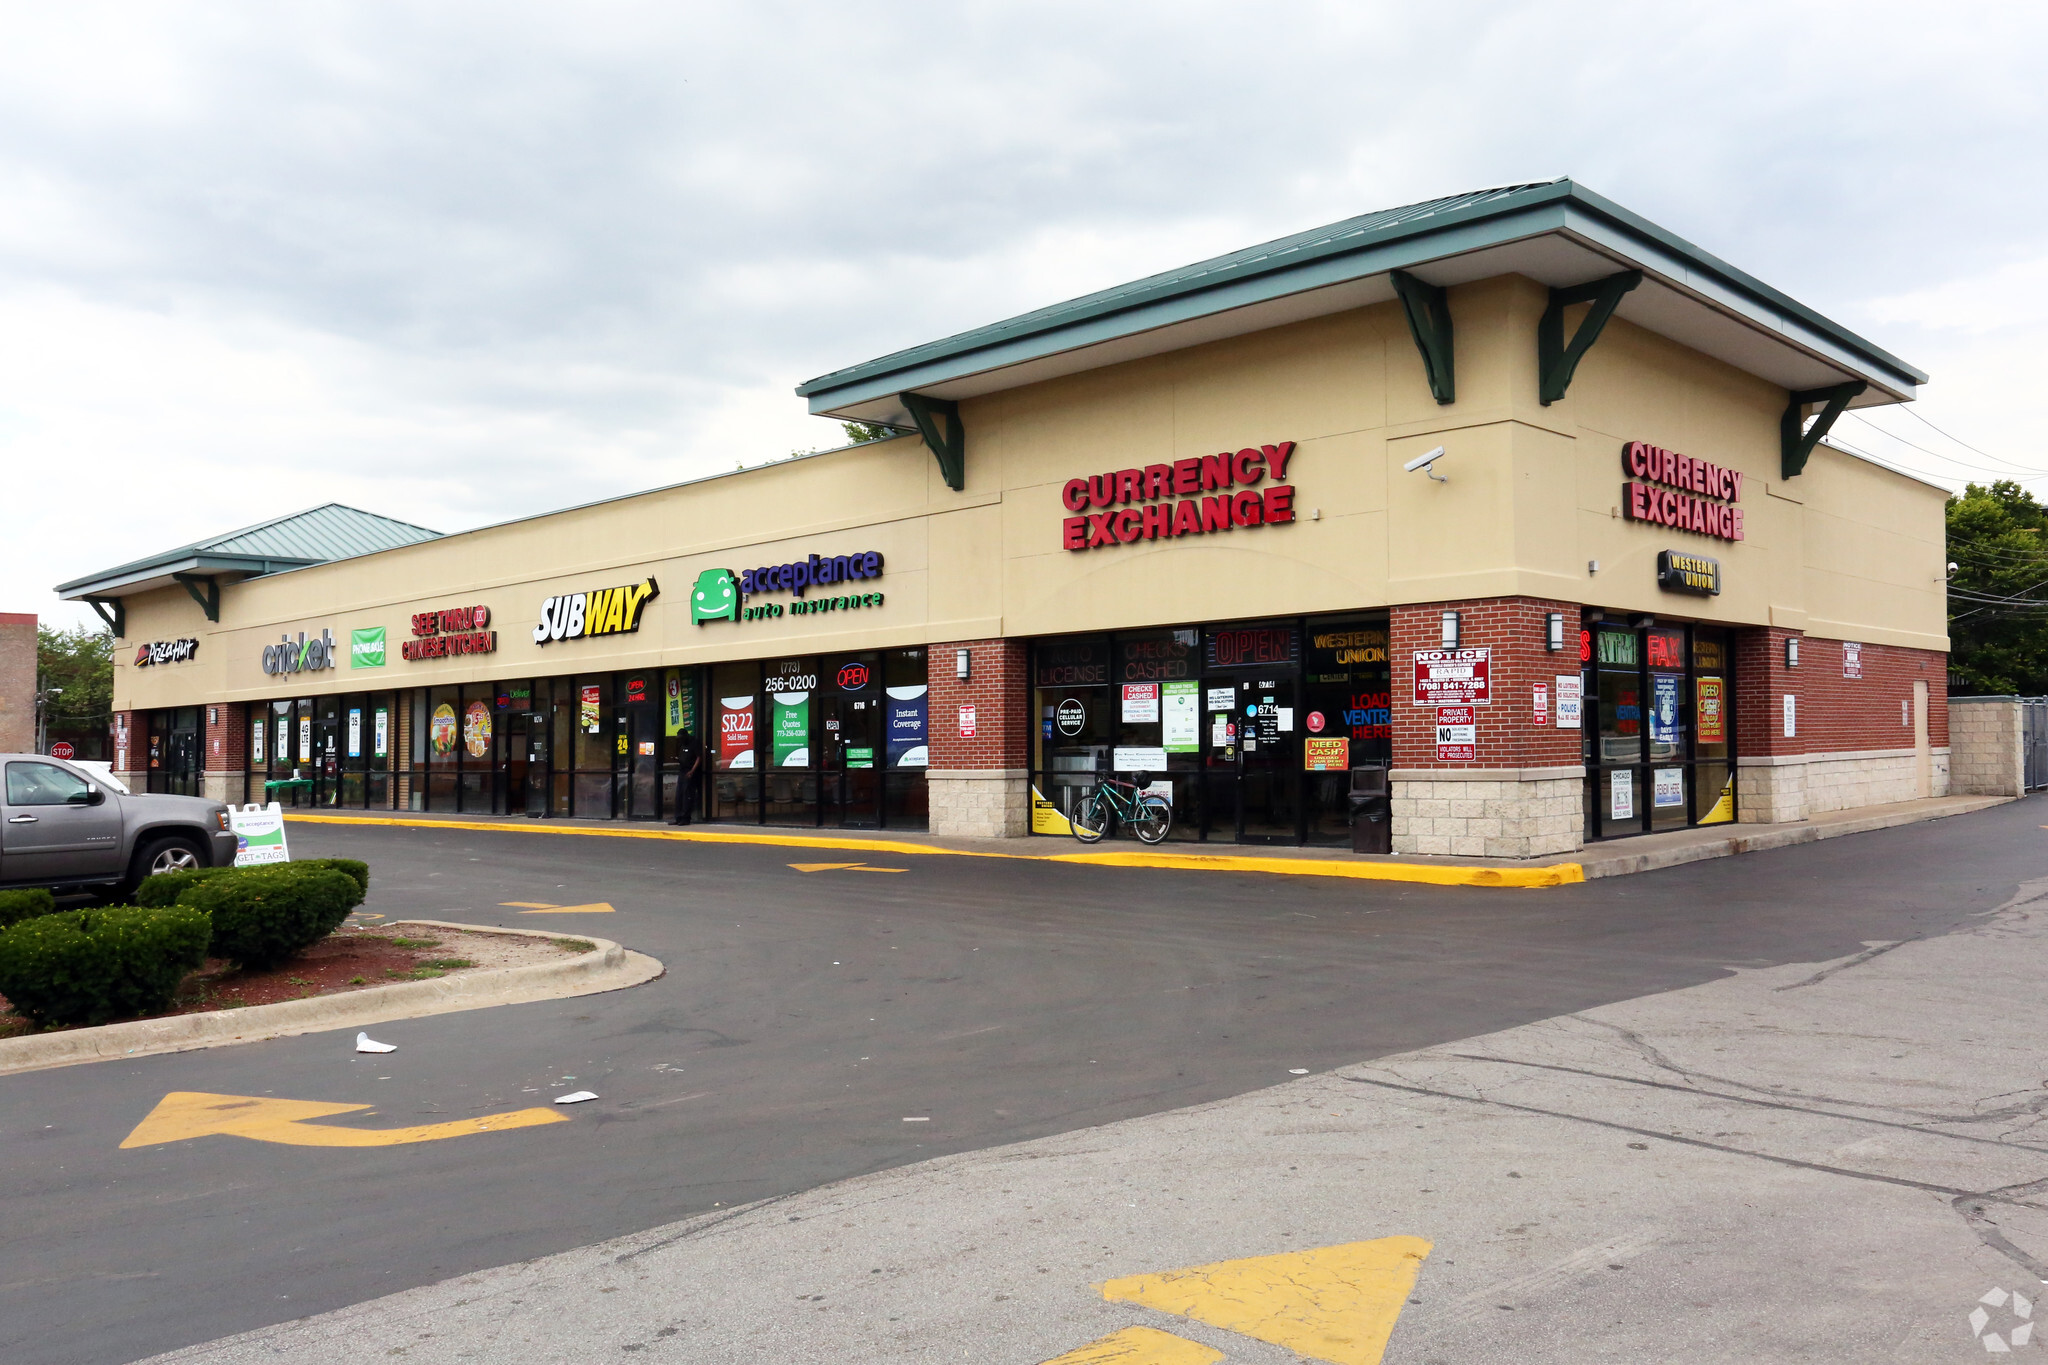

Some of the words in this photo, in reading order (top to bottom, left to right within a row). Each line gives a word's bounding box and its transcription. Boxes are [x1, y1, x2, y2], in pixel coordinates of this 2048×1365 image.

[1062, 441, 1297, 512] CURRENCY
[1622, 441, 1743, 503] CURRENCY
[1063, 485, 1296, 550] EXCHANGE
[1623, 482, 1744, 541] EXCHANGE
[741, 551, 884, 596] acceptance
[1671, 555, 1713, 575] WESTERN
[1685, 573, 1713, 589] UNION
[532, 576, 660, 646] SUBWAY
[743, 603, 783, 620] auto
[789, 592, 884, 616] insurance
[411, 611, 436, 636] SEE
[436, 607, 473, 632] THRU
[402, 637, 445, 660] CHINESE
[445, 631, 497, 656] KITCHEN
[1216, 630, 1290, 664] OPEN
[1314, 631, 1385, 649] WESTERN
[1598, 631, 1637, 665] ATM
[262, 628, 336, 675] cricket
[352, 643, 370, 655] PHONE
[1126, 641, 1188, 660] CHECKS
[1336, 647, 1385, 664] UNION
[1415, 650, 1488, 661] NOTICE
[1648, 635, 1681, 667] FAX
[780, 660, 801, 675] (773)
[1040, 664, 1105, 684] LICENSE
[1125, 660, 1188, 680] CASHED
[627, 680, 644, 690] OPEN
[765, 674, 817, 692] 256-0200
[837, 667, 869, 686] OPEN
[1418, 683, 1441, 691] (708)
[1443, 681, 1486, 690] 841-7288
[1258, 705, 1279, 713] 6714
[1351, 692, 1390, 709] LOAD
[1561, 704, 1577, 712] POLICE
[433, 714, 455, 725] Smoothies
[896, 709, 918, 717] Instant
[1438, 715, 1472, 724] PROPERTY
[1442, 708, 1468, 716] PRIVATE
[302, 724, 309, 733] 4G
[722, 713, 753, 733] SR22
[782, 720, 801, 730] Quotes
[893, 719, 922, 730] Coverage
[1352, 725, 1392, 739] HERE
[1439, 728, 1451, 742] NO
[53, 748, 73, 756] STOP
[617, 739, 628, 750] 24
[238, 854, 255, 862] GET
[261, 851, 284, 860] TAGS
